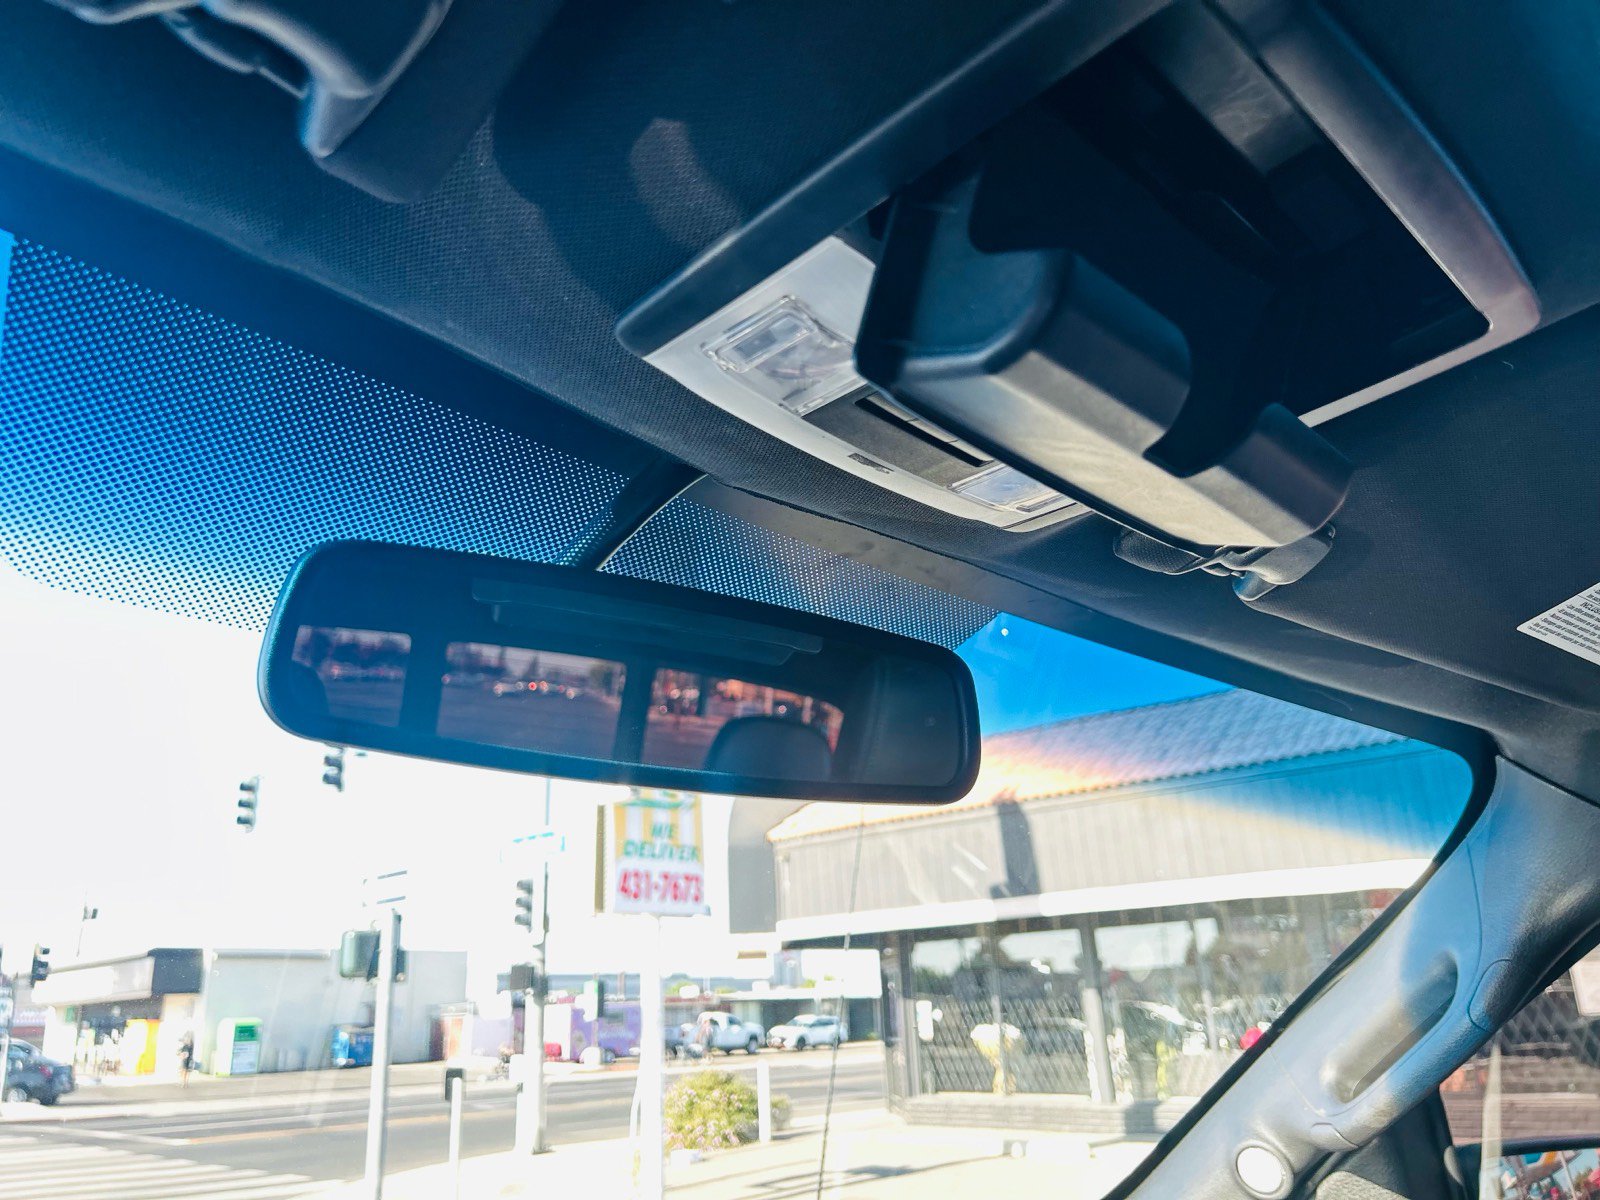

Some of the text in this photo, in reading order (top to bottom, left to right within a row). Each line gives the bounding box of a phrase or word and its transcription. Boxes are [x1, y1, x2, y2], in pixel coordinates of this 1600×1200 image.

[651, 822, 678, 839] WE
[623, 840, 699, 861] DELIVER
[619, 869, 702, 902] 431-7673
